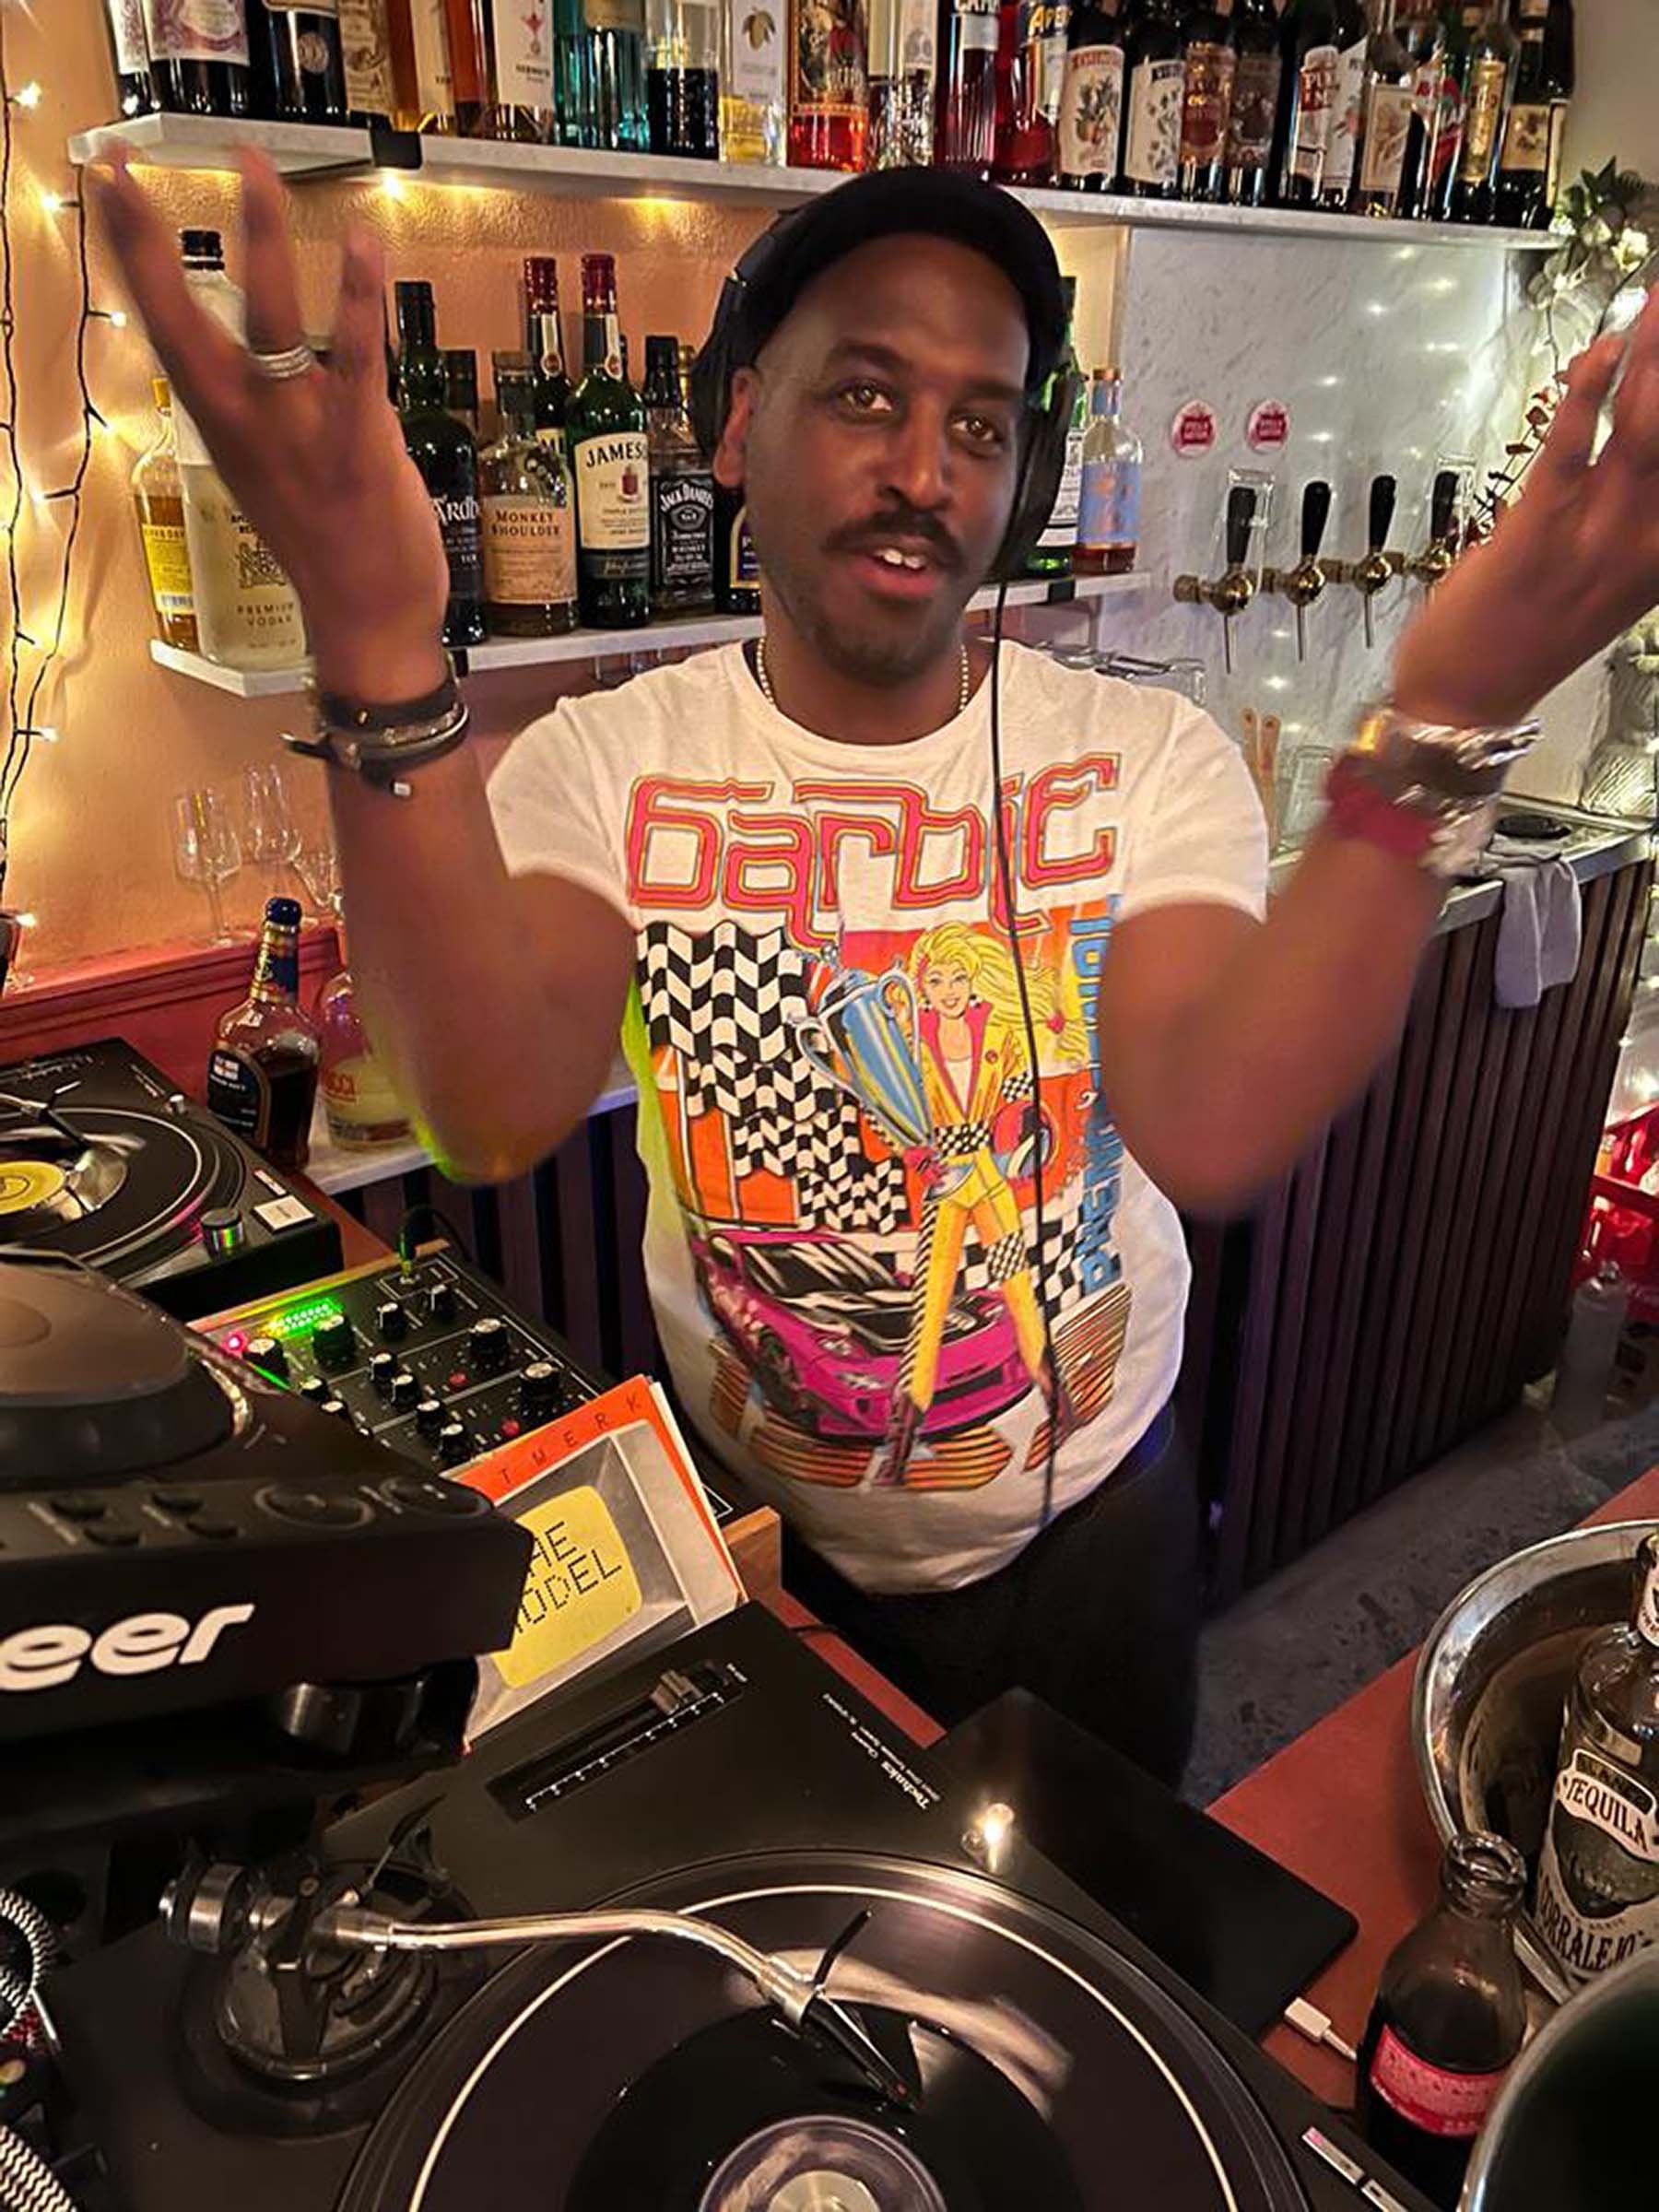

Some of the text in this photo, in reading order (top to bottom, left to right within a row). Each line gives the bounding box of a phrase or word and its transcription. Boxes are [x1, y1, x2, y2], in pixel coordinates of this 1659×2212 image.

[586, 442, 648, 468] JAMES
[495, 510, 554, 523] MONKEY
[660, 487, 683, 512] JACK
[529, 1520, 579, 1578] HE
[515, 1548, 623, 1634] ODEL
[881, 1760, 930, 1809] Technics
[1566, 1777, 1648, 1853] TEQUILA
